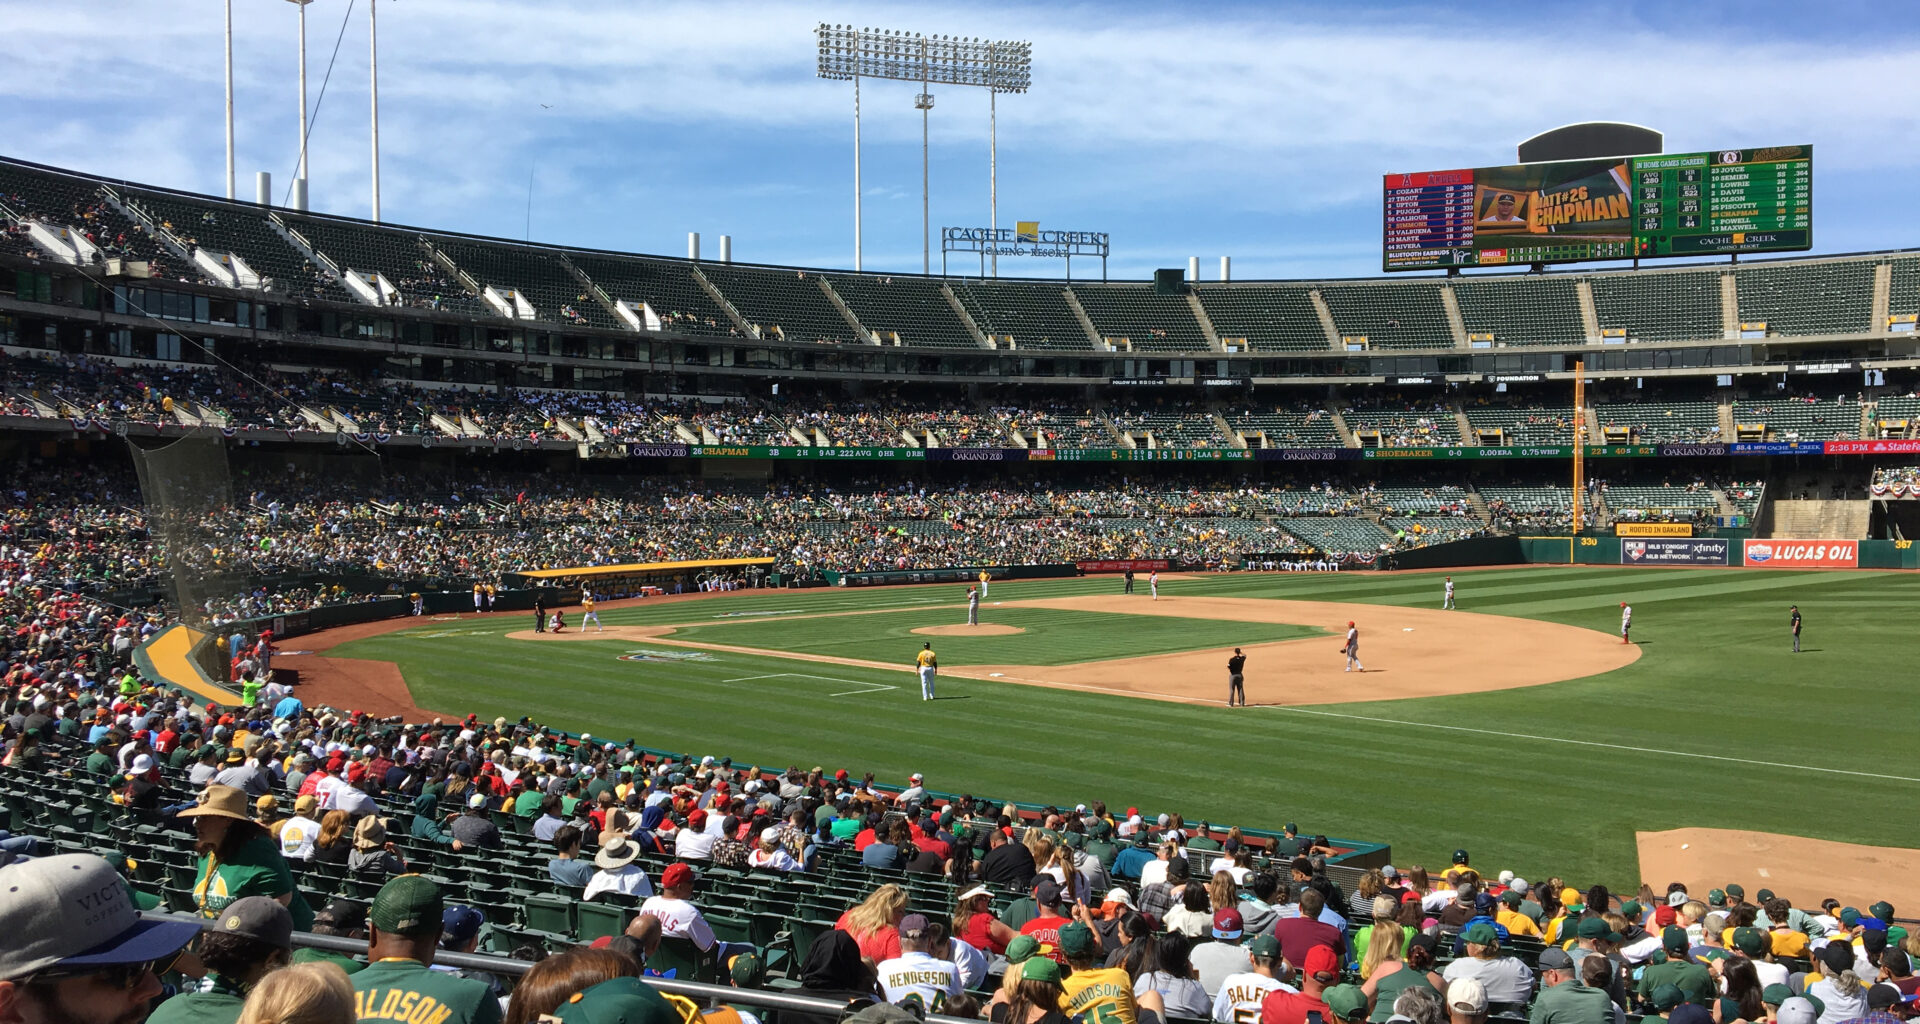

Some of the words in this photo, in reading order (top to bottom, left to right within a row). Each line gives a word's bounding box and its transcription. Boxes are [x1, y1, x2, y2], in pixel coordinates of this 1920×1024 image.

[1536, 192, 1630, 226] CHAPMAN
[949, 227, 1011, 240] CACHE
[1042, 231, 1103, 244] CREEK
[985, 247, 1024, 256] CASINO
[1031, 249, 1068, 257] RESORT
[634, 448, 671, 457] OAKLAND
[672, 448, 687, 457] ZOO
[1694, 544, 1724, 554] xfinity
[1774, 546, 1825, 560] LUCAS
[1829, 545, 1854, 560] OIL
[888, 971, 951, 988] HENDERSON
[1070, 984, 1120, 1009] HUDSON
